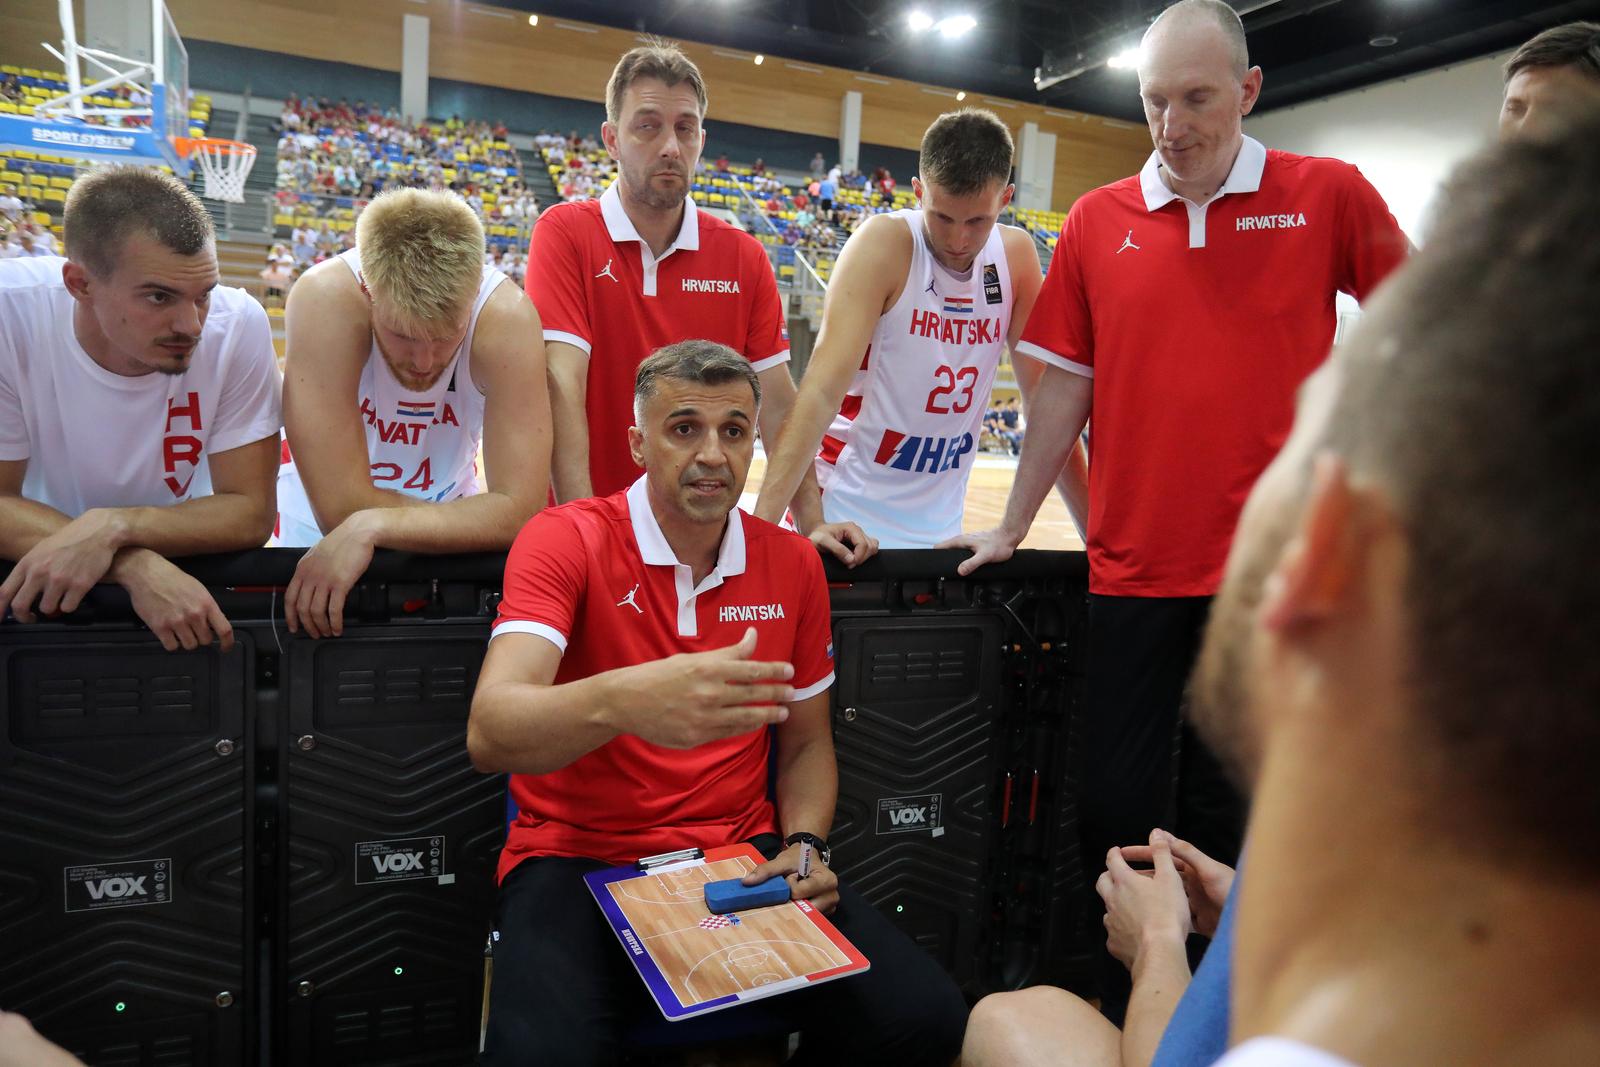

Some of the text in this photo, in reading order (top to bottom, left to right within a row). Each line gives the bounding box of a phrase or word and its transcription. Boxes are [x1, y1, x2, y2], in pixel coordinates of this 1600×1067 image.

[1236, 212, 1307, 231] HRVATSKA
[682, 279, 740, 293] HRVATSKA
[909, 309, 1000, 345] HRATSKA
[925, 364, 979, 414] 23
[915, 432, 974, 474] HEP
[719, 604, 785, 622] HRVATSKA
[889, 807, 927, 825] VOX
[372, 852, 425, 873] VOX
[85, 876, 148, 900] VOX
